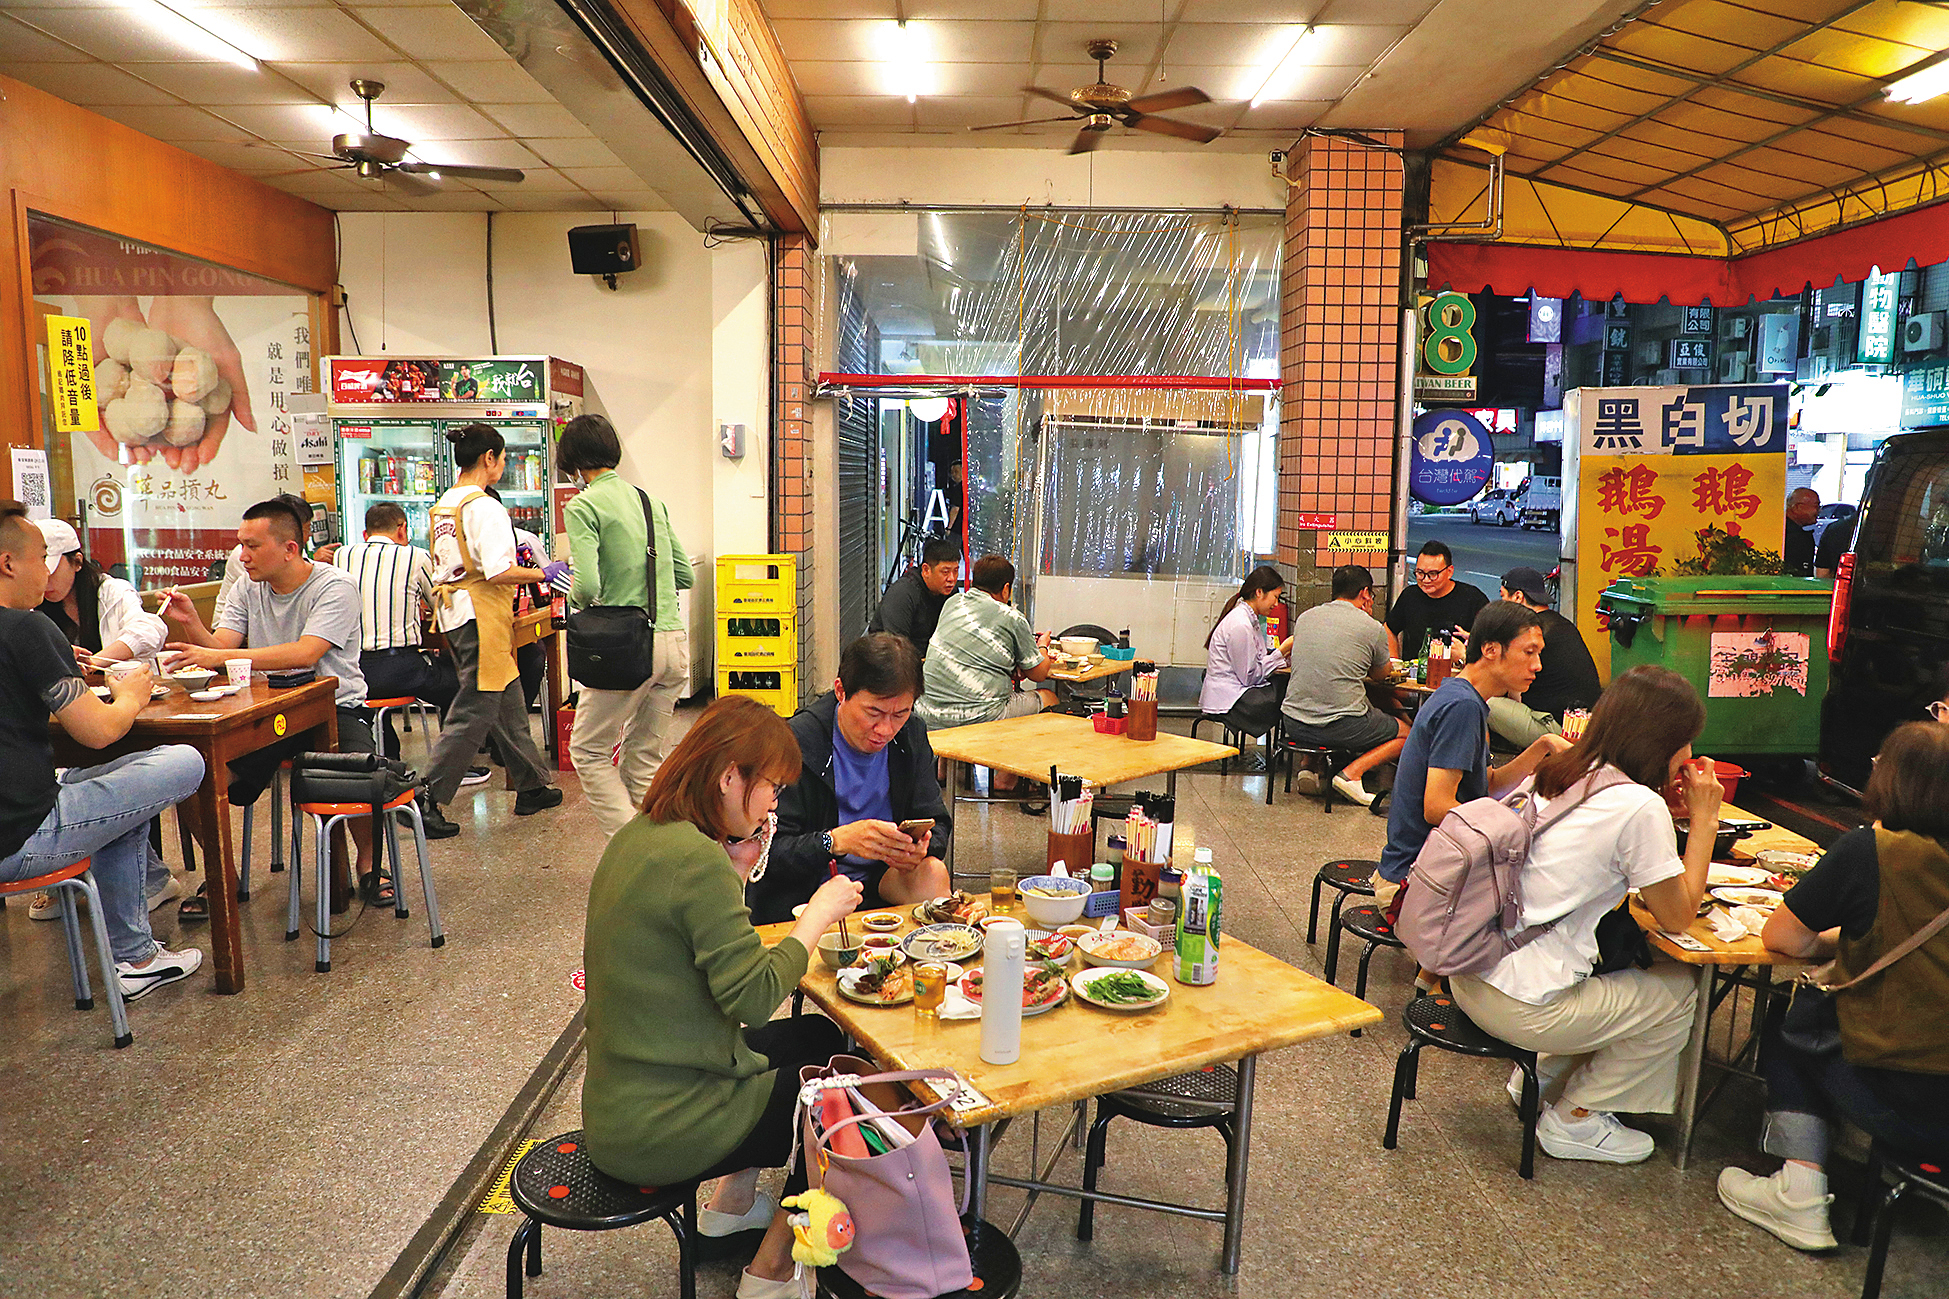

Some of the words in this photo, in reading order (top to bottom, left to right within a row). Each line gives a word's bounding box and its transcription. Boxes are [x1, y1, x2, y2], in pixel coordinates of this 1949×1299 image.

[75, 266, 124, 287] HUA
[134, 266, 177, 287] PIN
[1426, 294, 1477, 375] 8
[74, 326, 92, 400] 10點過後
[61, 329, 81, 426] 請降低音量
[1413, 378, 1441, 388] IWAN
[1444, 379, 1472, 389] BEER
[1907, 367, 1949, 392] 華碩
[1593, 395, 1774, 449] 黑白切
[301, 436, 328, 449] Asahi
[1418, 468, 1477, 484] 台灣代駕
